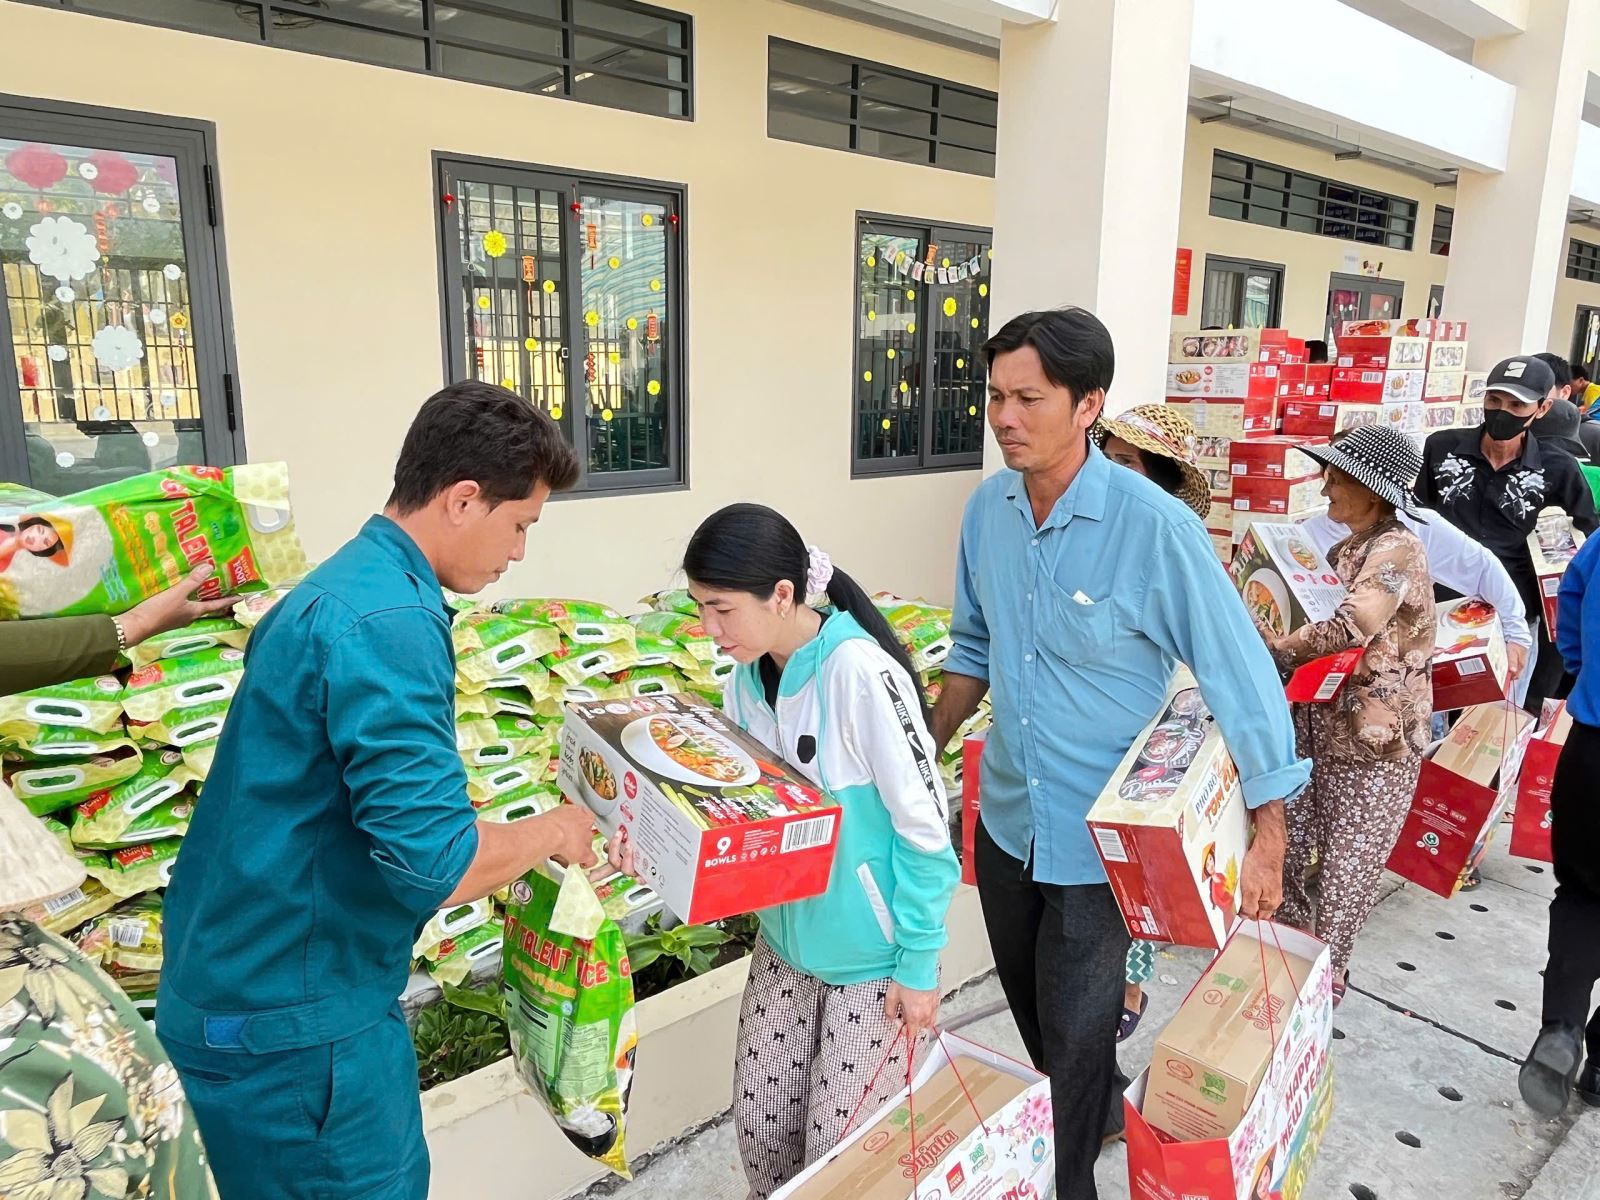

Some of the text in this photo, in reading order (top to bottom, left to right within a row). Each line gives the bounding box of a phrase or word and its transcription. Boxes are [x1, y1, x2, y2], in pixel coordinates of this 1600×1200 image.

[894, 701, 911, 726] NIKE
[917, 760, 933, 784] NIKE
[717, 837, 731, 855] 9
[704, 855, 737, 868] BOWLS
[1285, 1041, 1317, 1112] HAPPY
[1280, 1104, 1303, 1149] NEW
[898, 1129, 959, 1179] Sujata
